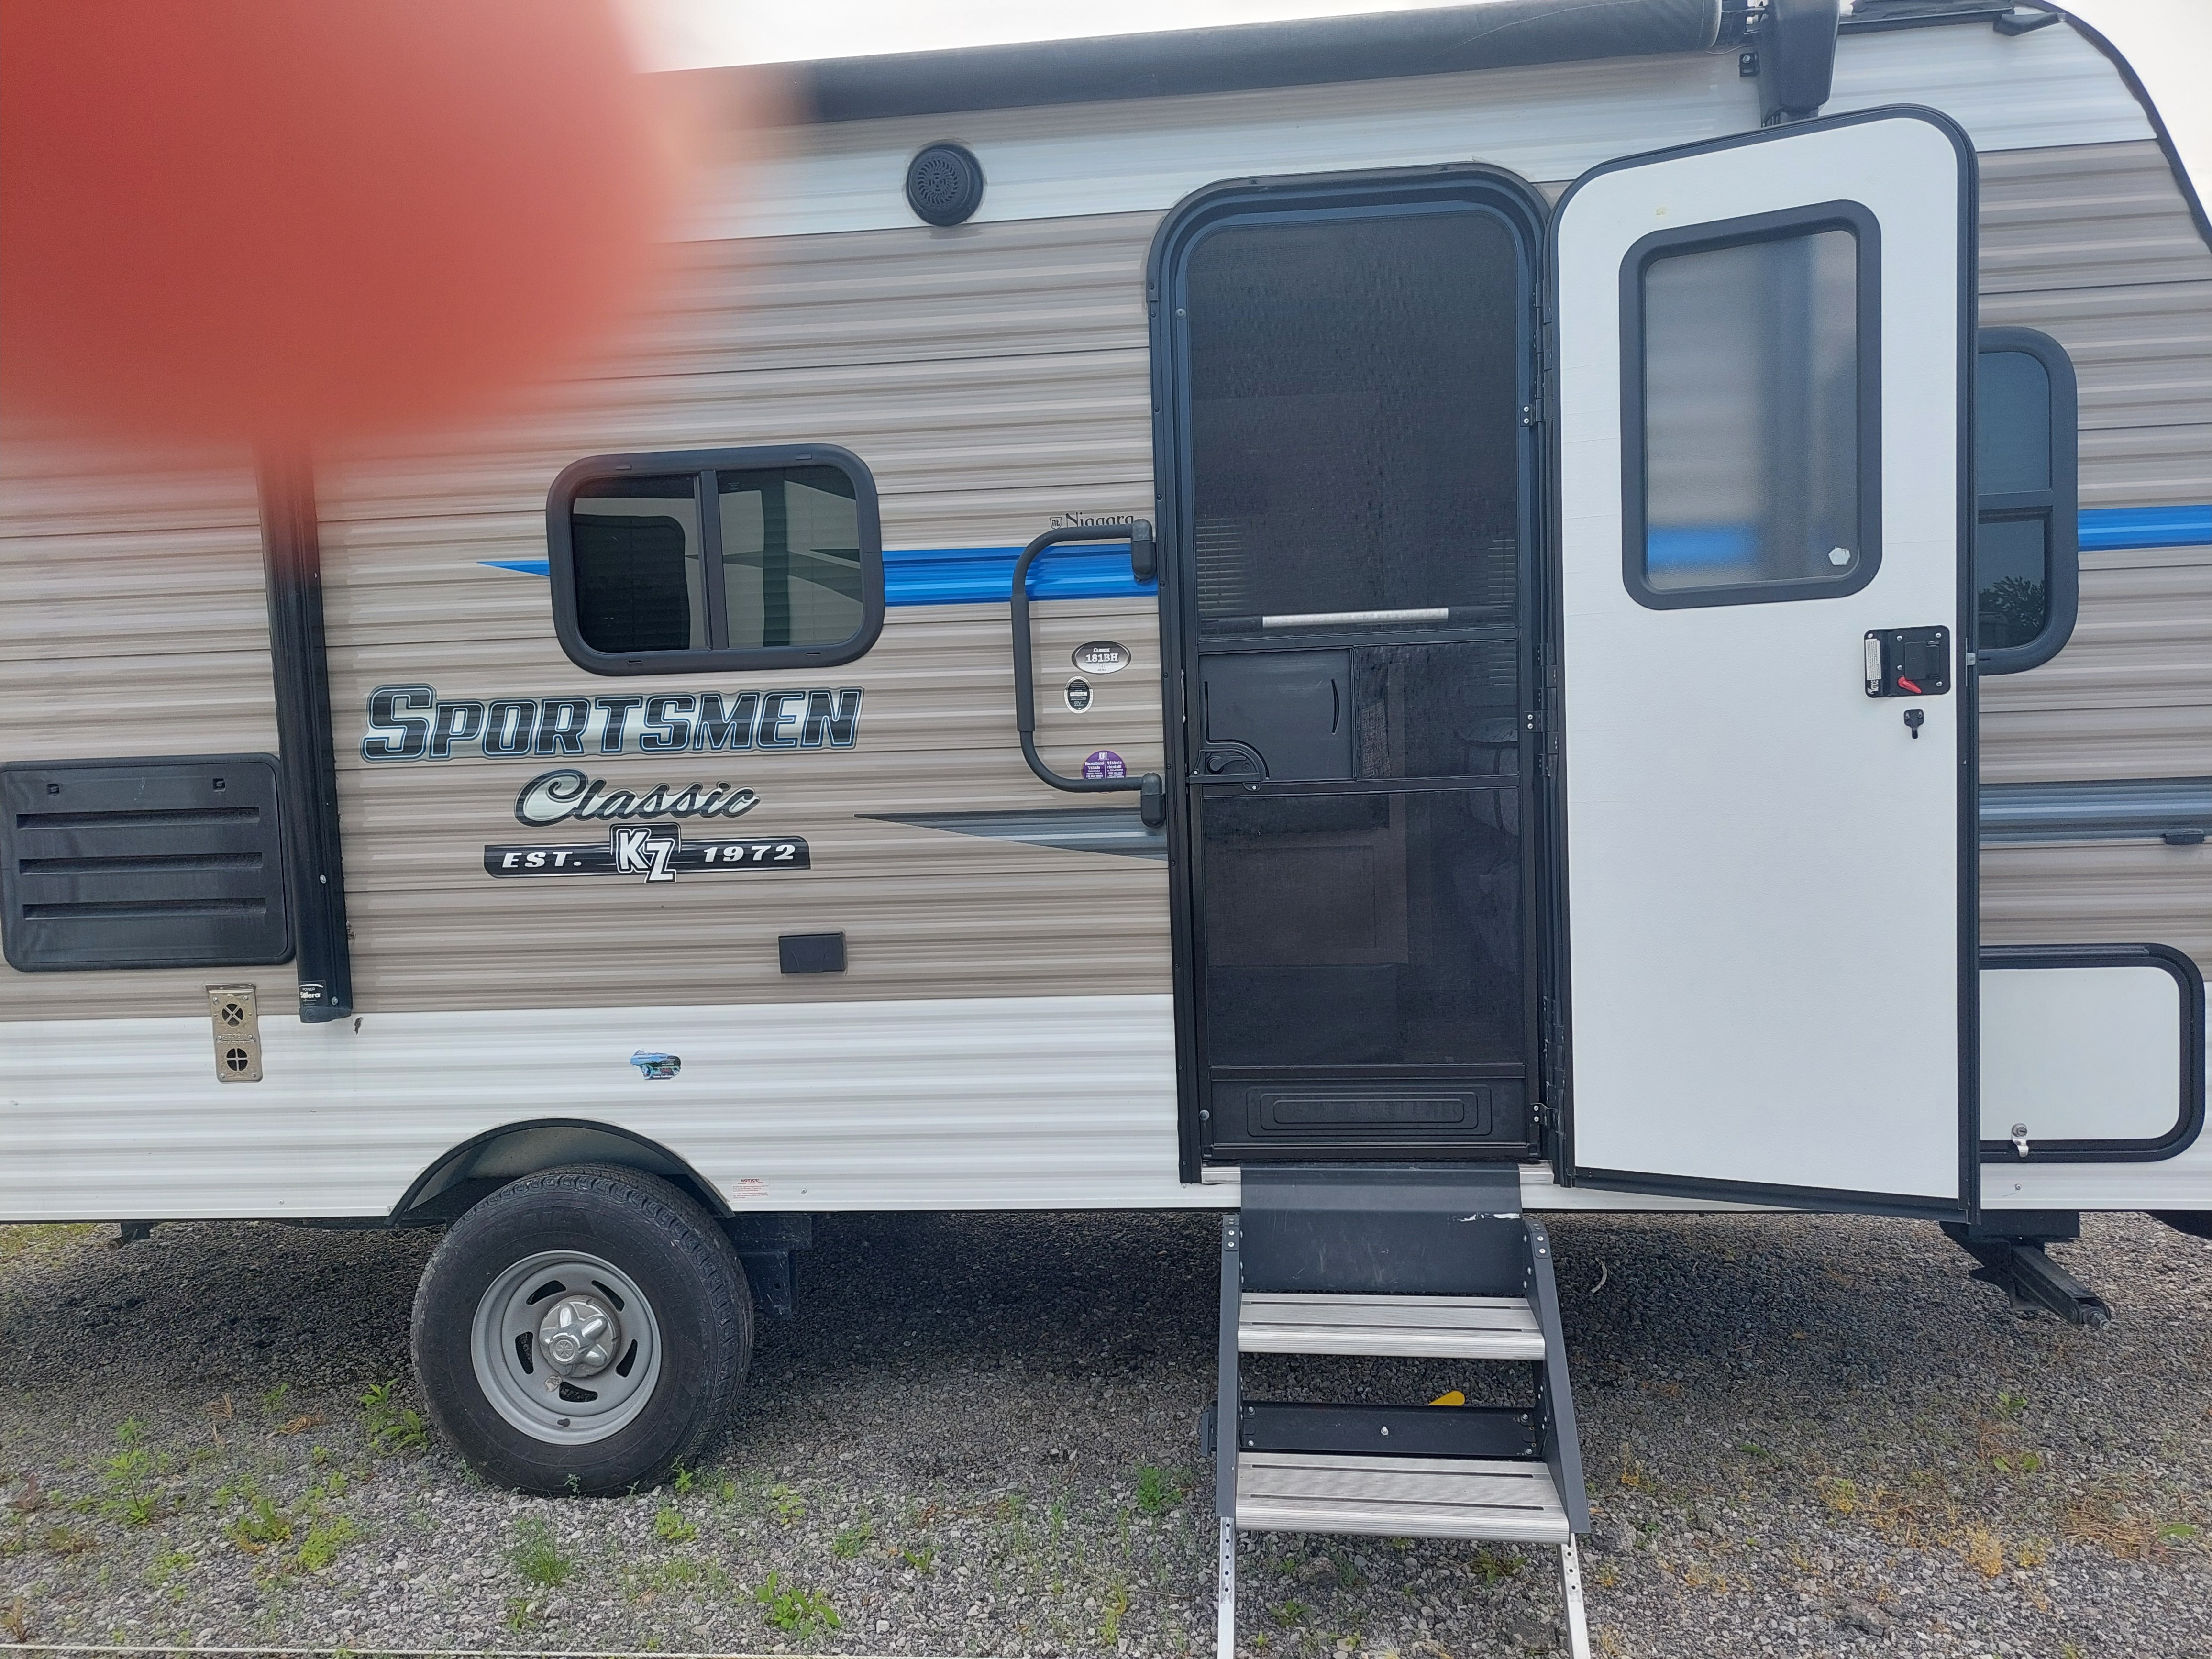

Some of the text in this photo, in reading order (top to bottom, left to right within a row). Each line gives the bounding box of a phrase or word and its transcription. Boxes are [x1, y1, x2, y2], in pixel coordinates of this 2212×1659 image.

[1086, 653, 1118, 663] 181BH
[362, 685, 863, 762] SPORTSMEN
[514, 768, 761, 827] Classic
[502, 829, 795, 883] EST. KZ 1972
